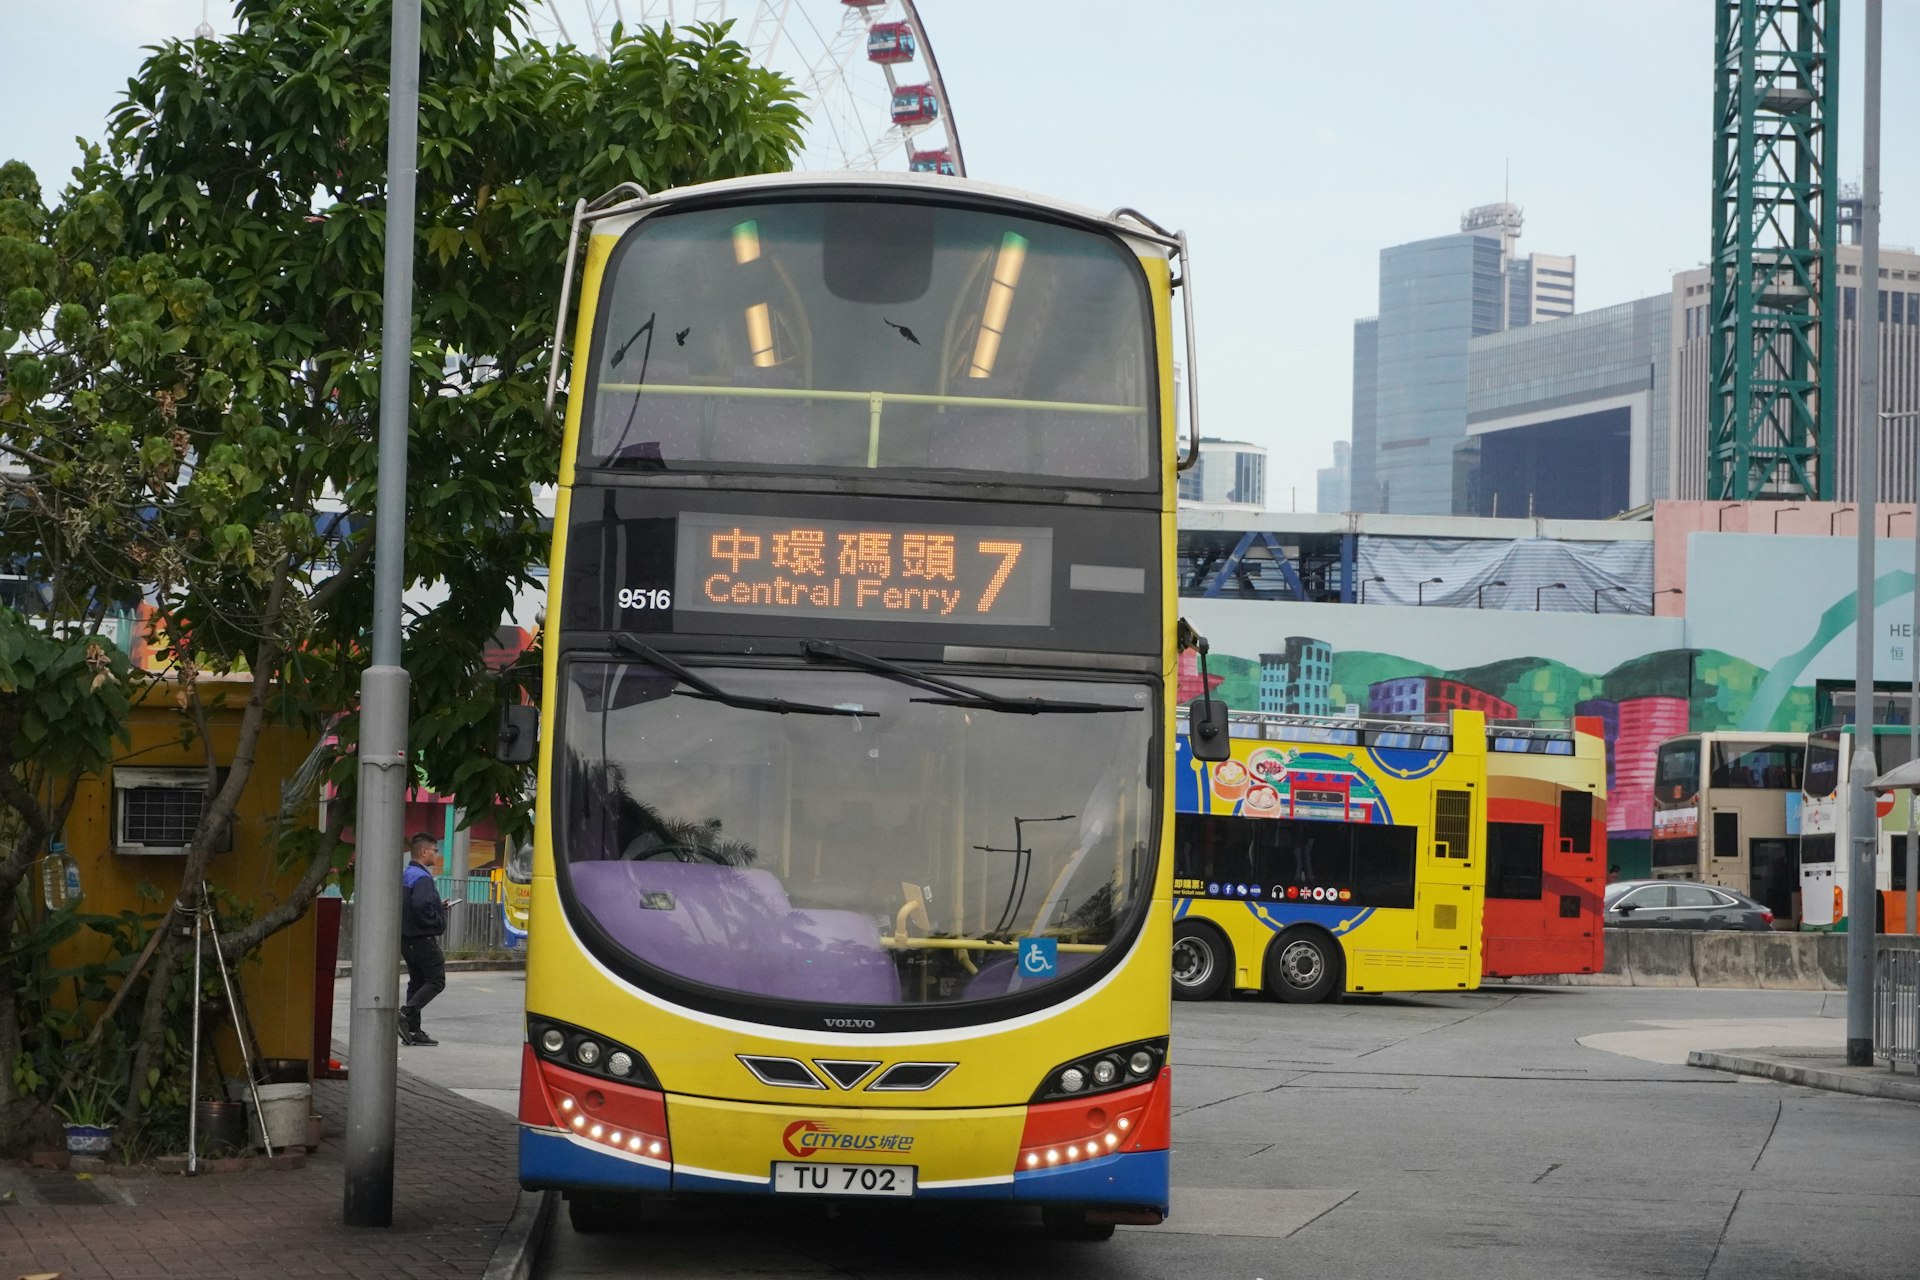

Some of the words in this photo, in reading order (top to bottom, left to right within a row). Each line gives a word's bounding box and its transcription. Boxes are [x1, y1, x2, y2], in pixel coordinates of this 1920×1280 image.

[711, 528, 955, 580] 中環碼頭
[977, 542, 1022, 613] 7
[618, 588, 671, 610] 9516
[705, 574, 839, 607] Central
[857, 580, 960, 615] Ferry
[1890, 624, 1914, 637] HE
[823, 1018, 876, 1029] VOLVO
[801, 1132, 878, 1149] CITYBUS
[879, 1134, 914, 1150] 城巴
[793, 1166, 829, 1189] TU
[842, 1167, 896, 1191] 702
